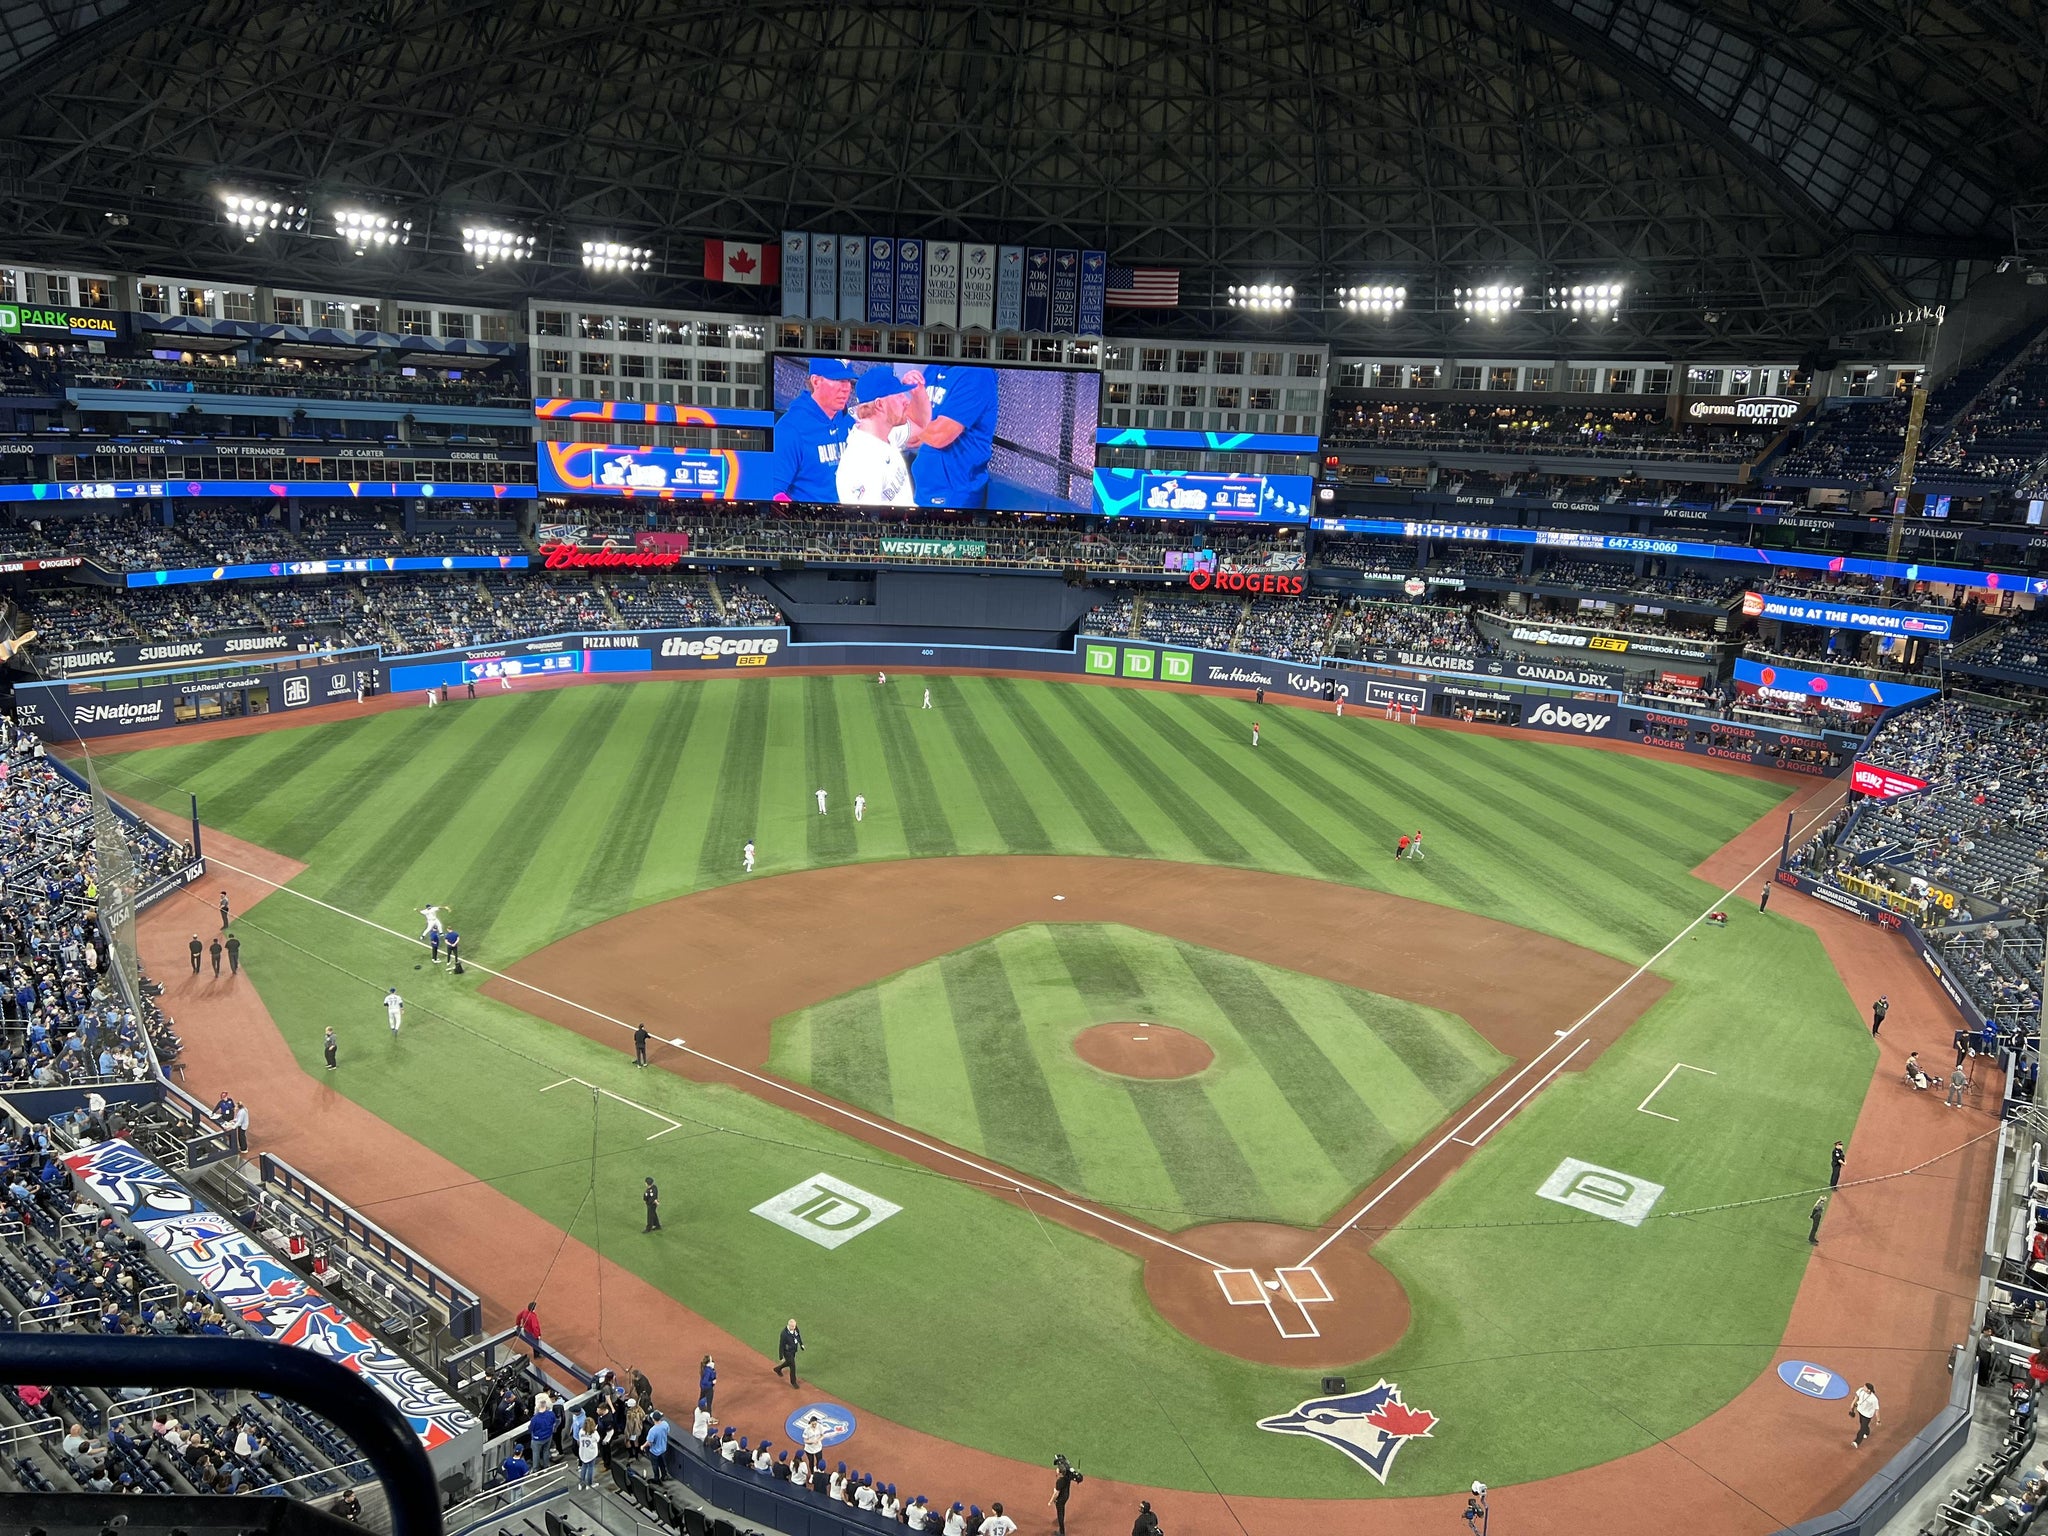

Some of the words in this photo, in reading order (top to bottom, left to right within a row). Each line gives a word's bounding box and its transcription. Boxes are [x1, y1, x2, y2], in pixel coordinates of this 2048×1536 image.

[872, 260, 890, 271] 1992
[900, 262, 919, 272] 1993
[929, 264, 955, 278] 1992
[966, 266, 991, 280] 1993
[1029, 270, 1047, 280] 2016
[1083, 273, 1102, 283] 2025
[927, 279, 956, 290] WORLD
[963, 282, 992, 292] WORLD
[1029, 281, 1047, 291] ALDS
[1055, 278, 1074, 287] 2016
[927, 289, 956, 299] SERIES
[963, 290, 991, 300] SERIES
[1054, 290, 1074, 300] 2020
[871, 302, 890, 312] ALCS
[898, 303, 918, 313] ALCS
[1054, 304, 1073, 313] 2022
[21, 309, 68, 326] PARK
[69, 317, 116, 331] SOCIAL
[1053, 317, 1073, 327] 2023
[1081, 314, 1100, 324] ALCS
[1689, 402, 1735, 418] Corona
[1736, 403, 1798, 418] ROOFTOP
[1751, 417, 1778, 425] PATIO
[96, 446, 117, 454] 4306
[118, 446, 138, 454] TOM
[139, 446, 165, 454] CHEEK
[216, 446, 239, 455] TONY
[241, 447, 285, 456] FERNANDEZ
[338, 449, 354, 457] JOE
[356, 449, 384, 458] CARTER
[450, 452, 480, 460] GEORGE
[482, 453, 498, 461] BELL
[1456, 496, 1474, 504] DAVE
[1475, 497, 1495, 505] STIEB
[1570, 503, 1600, 512] GASTON
[1663, 509, 1678, 517] PAT
[1679, 510, 1708, 519] GILLICK
[1778, 517, 1797, 526] PAUL
[1799, 519, 1835, 529] BEESTON
[1900, 527, 1917, 536] ROY
[1918, 528, 1963, 540] HALLADAY
[881, 541, 941, 557] WESTJET
[958, 544, 985, 552] FLIGHT
[1608, 538, 1678, 553] 647-559-0060
[538, 543, 681, 569] Budweiser
[4, 563, 23, 572] TEAM
[46, 559, 71, 568] ROGERS
[1215, 571, 1303, 594] ROGERS
[1363, 572, 1391, 580] CANADA
[1428, 577, 1465, 585] BLEACHERS
[1764, 602, 1787, 615] JOIN
[1789, 605, 1804, 618] US
[1806, 609, 1823, 620] AT
[1824, 610, 1847, 622] THE
[1850, 613, 1900, 628] PORCH!
[224, 636, 288, 652] SUBWAY
[582, 636, 611, 649] PIZZA
[613, 636, 639, 648] NOVA
[660, 635, 779, 656] theScore
[1512, 627, 1587, 647] theScore
[1591, 638, 1628, 650] BET
[1631, 643, 1674, 655] SPORTSBOOK
[1680, 649, 1706, 659] CASINO
[138, 643, 204, 661] SUBWAY
[50, 651, 116, 670] SUBWAY
[739, 656, 765, 665] BET
[1090, 651, 1113, 669] TD
[1127, 654, 1151, 672] TD
[1165, 657, 1190, 676] TD
[1208, 666, 1230, 681] Tim
[1229, 667, 1272, 686] Hortons
[1516, 665, 1576, 683] CANADA
[181, 681, 227, 694] CLEAResult
[227, 678, 254, 688] Canada
[1287, 672, 1349, 697] Kubota
[1443, 686, 1466, 696] Active
[326, 688, 352, 697] HONDA
[1373, 688, 1395, 699] THE
[1397, 692, 1419, 703] KEG
[1769, 688, 1807, 702] ROGERS
[95, 699, 161, 720] National
[119, 717, 134, 725] Car
[135, 714, 160, 724] Rental
[1527, 703, 1611, 733] Sobeys
[1655, 714, 1689, 727] ROGERS
[1720, 725, 1756, 738] ROGERS
[1652, 737, 1685, 750] ROGERS
[1790, 736, 1828, 750] ROGERS
[1841, 740, 1858, 750] 328
[1717, 748, 1752, 762] ROGERS
[1786, 761, 1824, 775] ROGERS
[1855, 771, 1883, 789] HEINZ
[184, 862, 204, 882] VISA
[1778, 871, 1799, 887] HEINZ
[1816, 886, 1838, 899] CANADIAN
[108, 905, 130, 928] VISA
[1877, 912, 1902, 928] HEINZ
[1559, 1170, 1635, 1208] TD
[789, 1184, 872, 1231] TD
[581, 1439, 592, 1448] 19
